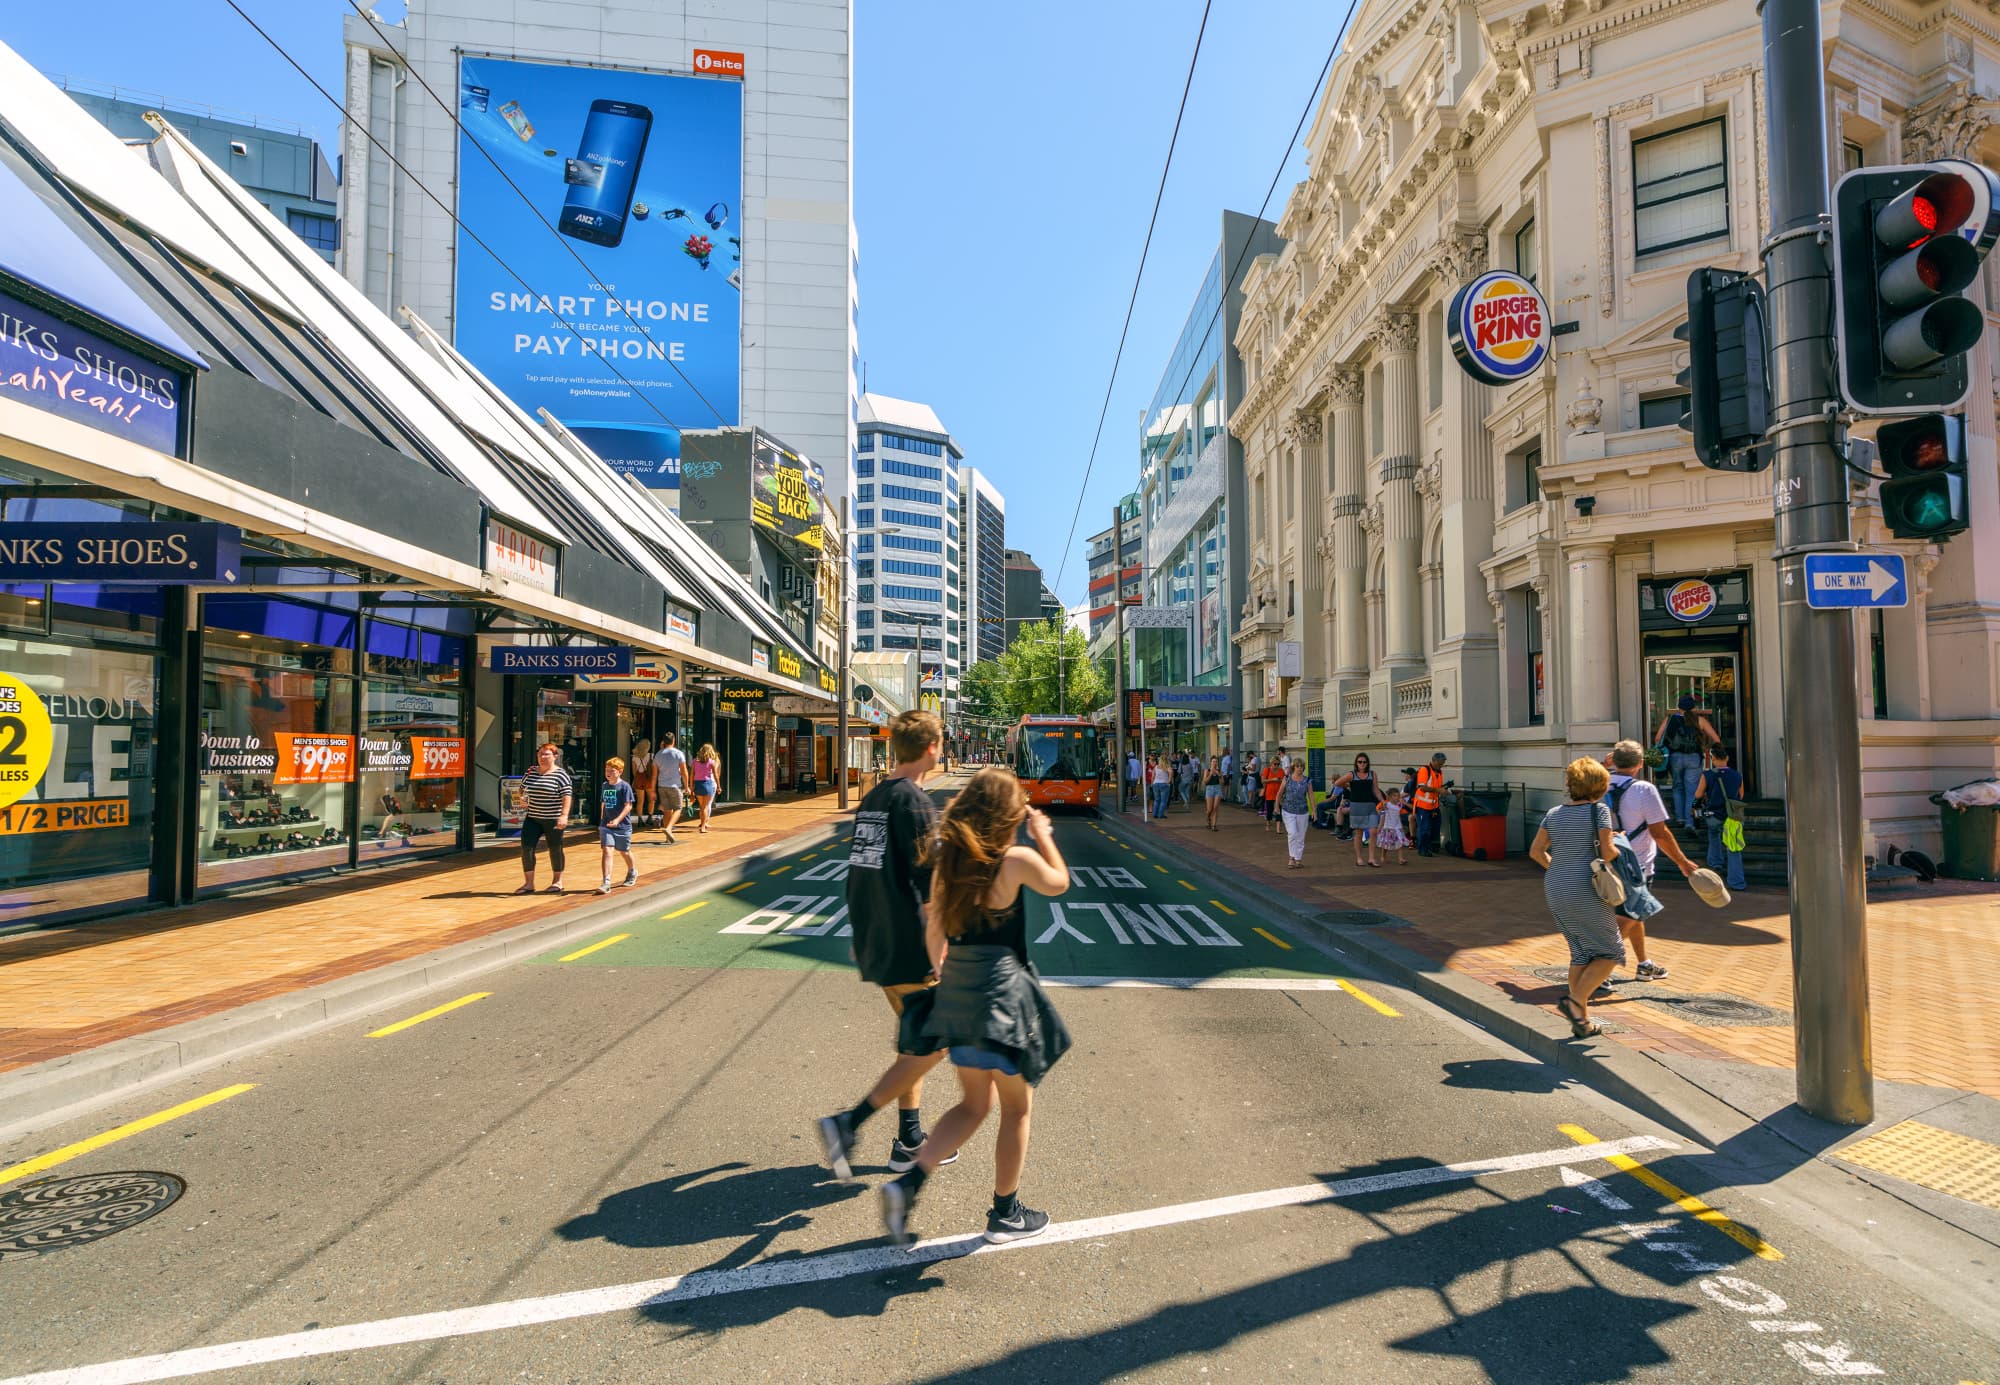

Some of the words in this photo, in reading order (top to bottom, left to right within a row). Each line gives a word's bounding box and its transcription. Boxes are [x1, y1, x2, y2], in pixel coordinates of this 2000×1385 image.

[588, 283, 616, 292] YOUR
[490, 291, 596, 317] SMART
[606, 300, 709, 323] PHONE
[1474, 296, 1538, 324] BURGER
[551, 322, 575, 331] JUST
[579, 323, 620, 333] BECAME
[624, 325, 651, 334] YOUR
[1476, 313, 1541, 350] KING
[515, 334, 571, 355] PAY
[581, 337, 685, 362] PHONE
[74, 346, 175, 410] SHOES
[525, 374, 538, 384] Tap
[540, 374, 553, 383] and
[555, 377, 568, 385] pay
[570, 375, 585, 384] with
[587, 376, 616, 386] selected
[618, 378, 645, 387] Android
[777, 473, 808, 501] YOUR
[778, 493, 808, 521] BACK
[1784, 573, 1794, 586] 4
[1825, 575, 1844, 587] ONE
[1848, 575, 1867, 587] WAY
[1672, 584, 1709, 604] BURGER
[1674, 592, 1711, 614] KING
[504, 652, 560, 668] BANKS
[564, 652, 617, 668] SHOES
[1158, 691, 1227, 702] Hannahs
[245, 734, 261, 750] to
[360, 736, 389, 751] Down
[391, 739, 402, 751] to
[28, 723, 132, 800] LE
[209, 749, 275, 767] business
[368, 751, 411, 765] business
[0, 770, 29, 782] LESS
[56, 803, 126, 827] PRICE!
[1068, 866, 1148, 889] BU
[1033, 902, 1244, 946] ONLY
